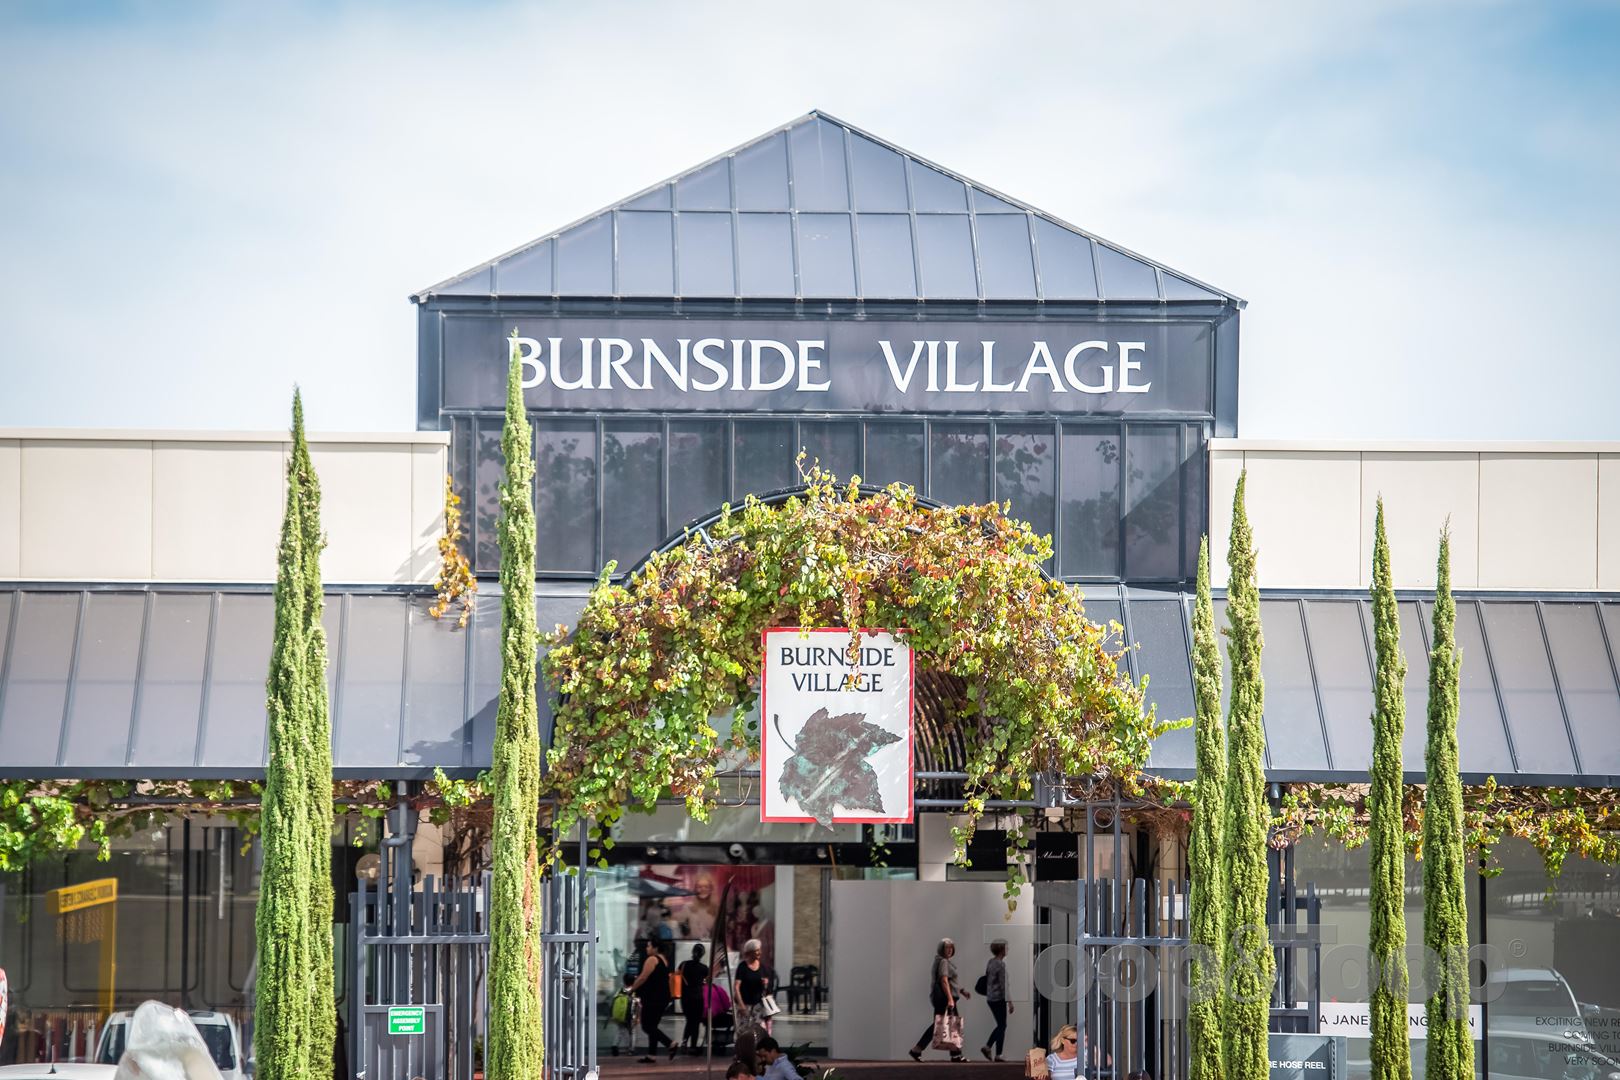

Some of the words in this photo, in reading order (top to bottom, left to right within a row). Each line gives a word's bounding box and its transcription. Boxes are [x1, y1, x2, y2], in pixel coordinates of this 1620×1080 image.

[507, 337, 830, 392] BURNSIDE
[878, 340, 1152, 395] VILLAGE
[791, 673, 884, 693] VILLAGE
[1535, 1016, 1582, 1026] EXCITING
[1585, 1017, 1608, 1027] NEW
[1563, 1030, 1610, 1040] COMING
[1548, 1043, 1596, 1053] BURNSIDE
[1279, 1060, 1303, 1069] HOSE
[1304, 1061, 1327, 1070] REEL
[1564, 1056, 1589, 1066] VERY
